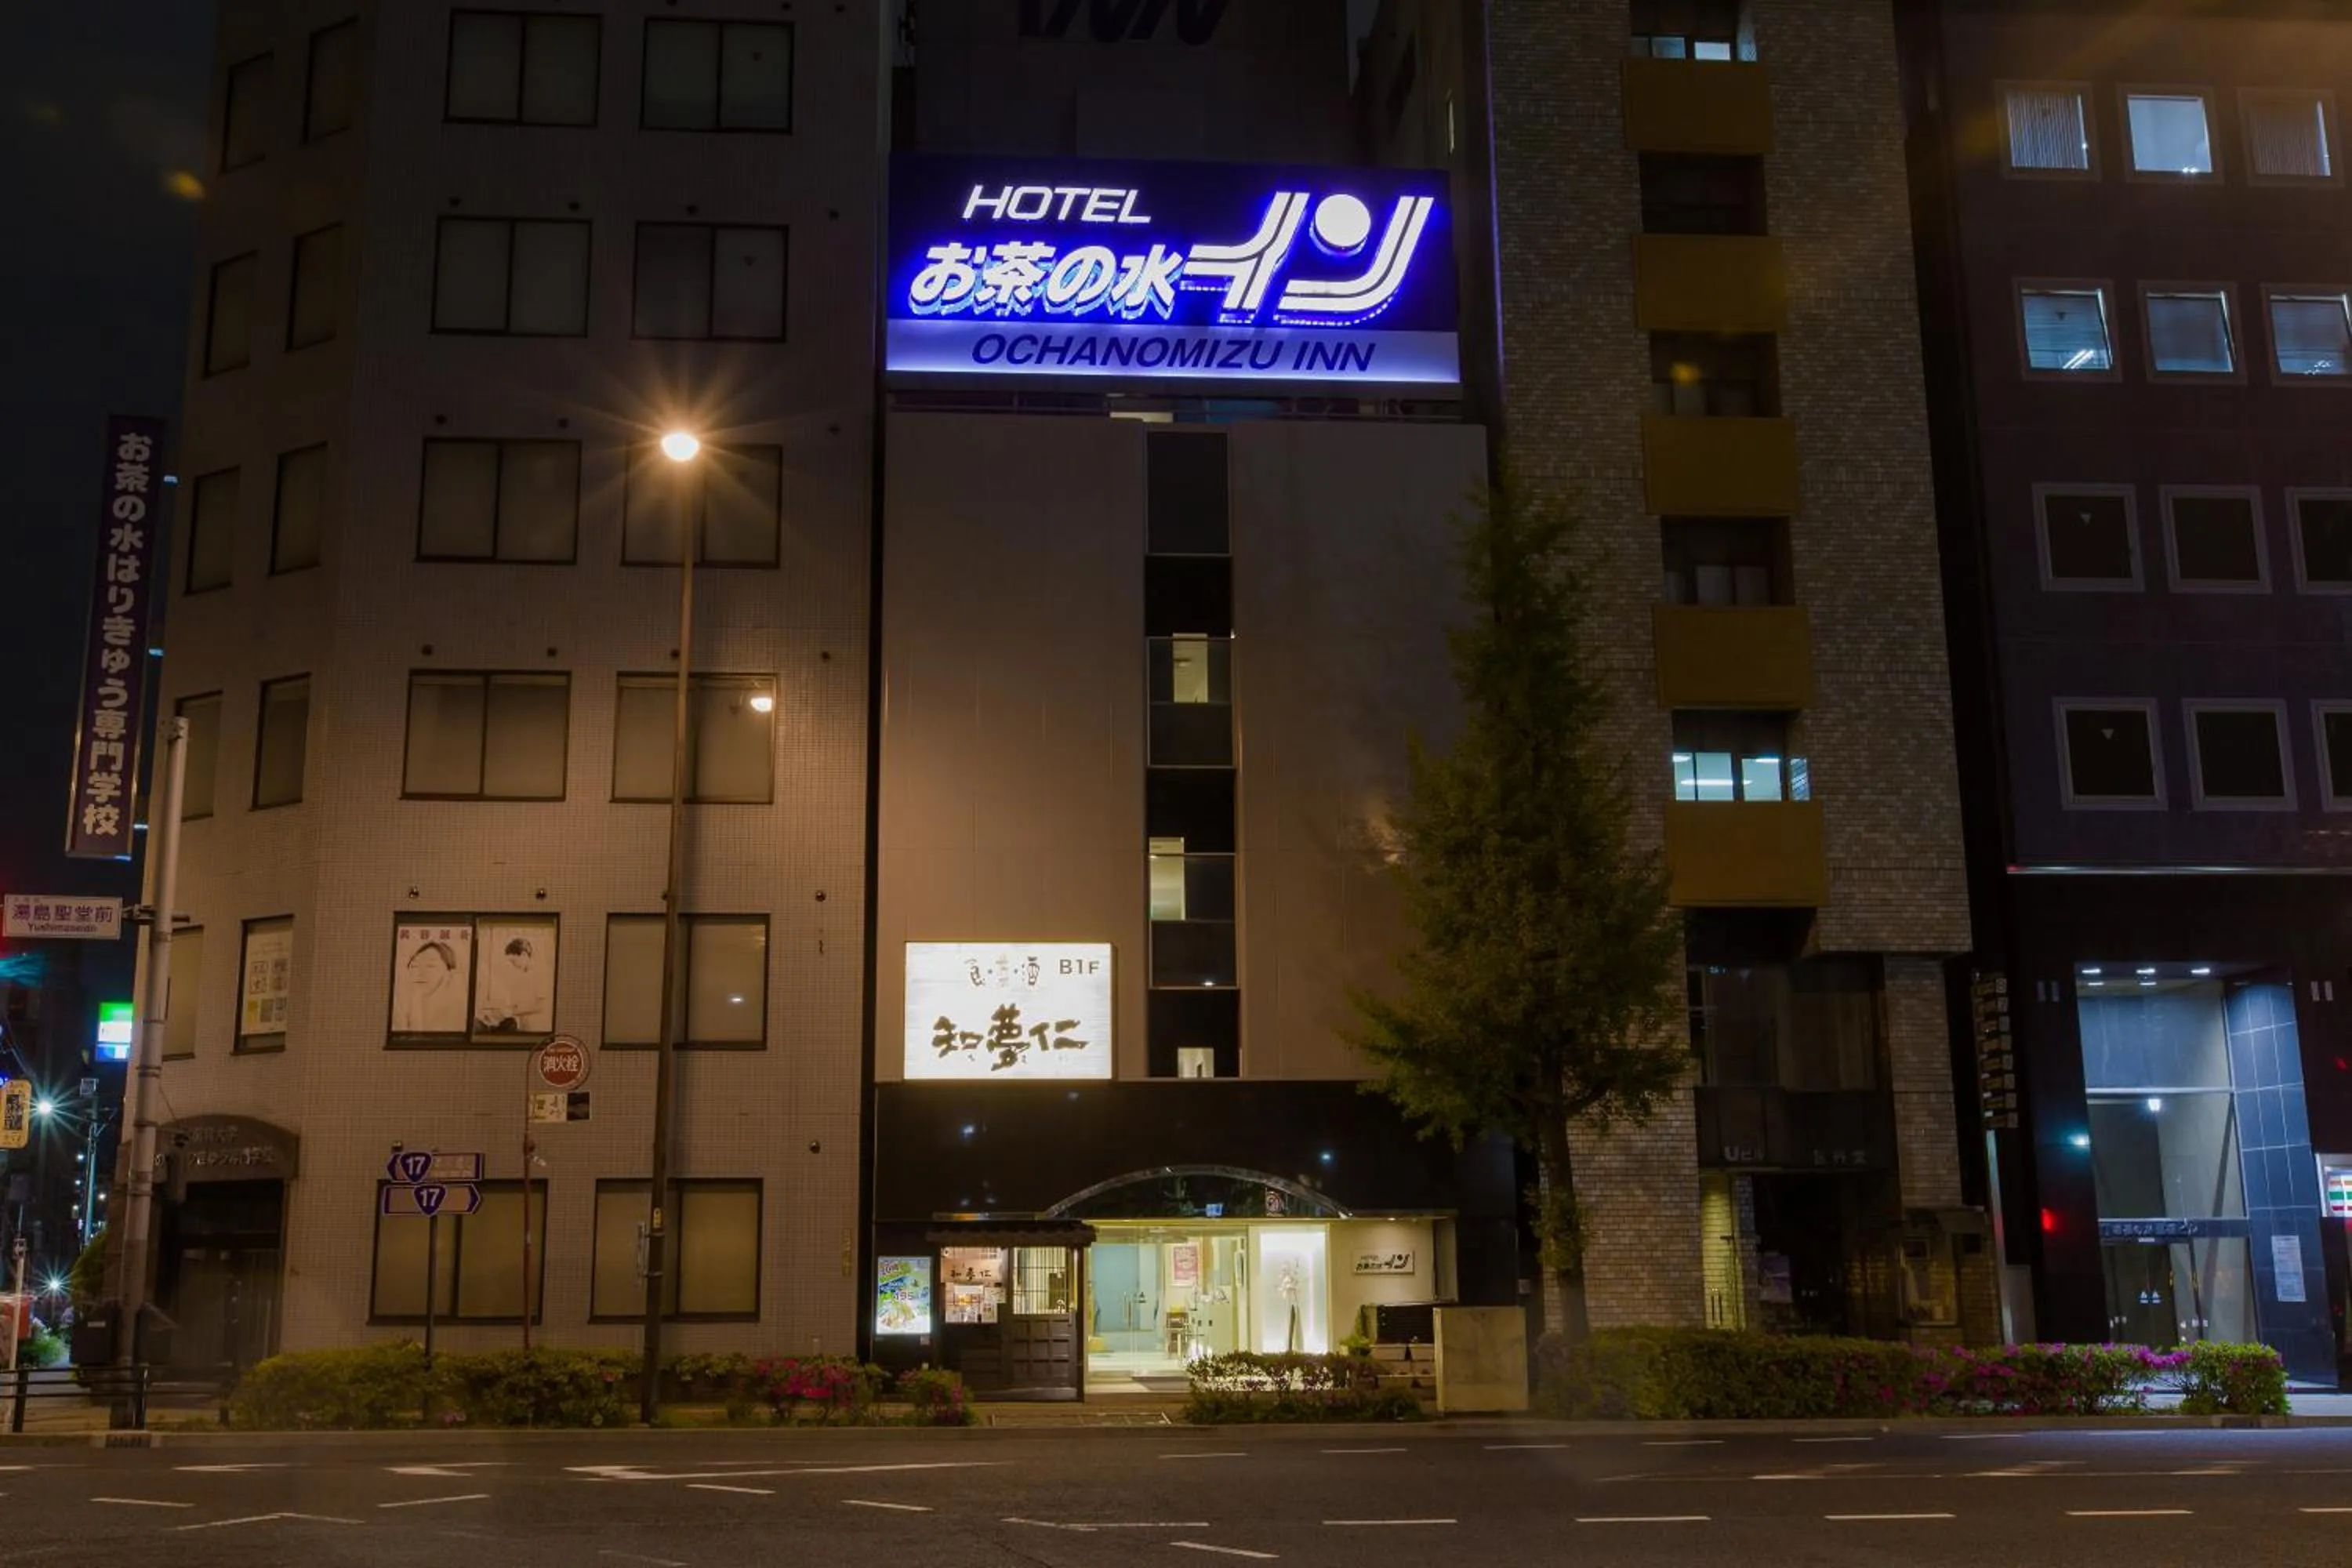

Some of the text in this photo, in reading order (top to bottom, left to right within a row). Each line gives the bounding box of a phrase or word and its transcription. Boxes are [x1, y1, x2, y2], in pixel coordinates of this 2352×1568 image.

[961, 184, 1152, 223] HOTEL
[909, 191, 1435, 312] お茶の水イン
[971, 333, 1376, 371] OCHANOMIZU INN
[82, 431, 153, 837] お茶の水はりきゅう専門学校
[13, 904, 114, 923] 湯島聖堂前
[1059, 959, 1100, 975] B1F
[543, 1054, 579, 1073] 消火栓
[405, 1156, 426, 1175] 17
[419, 1188, 441, 1207] 17
